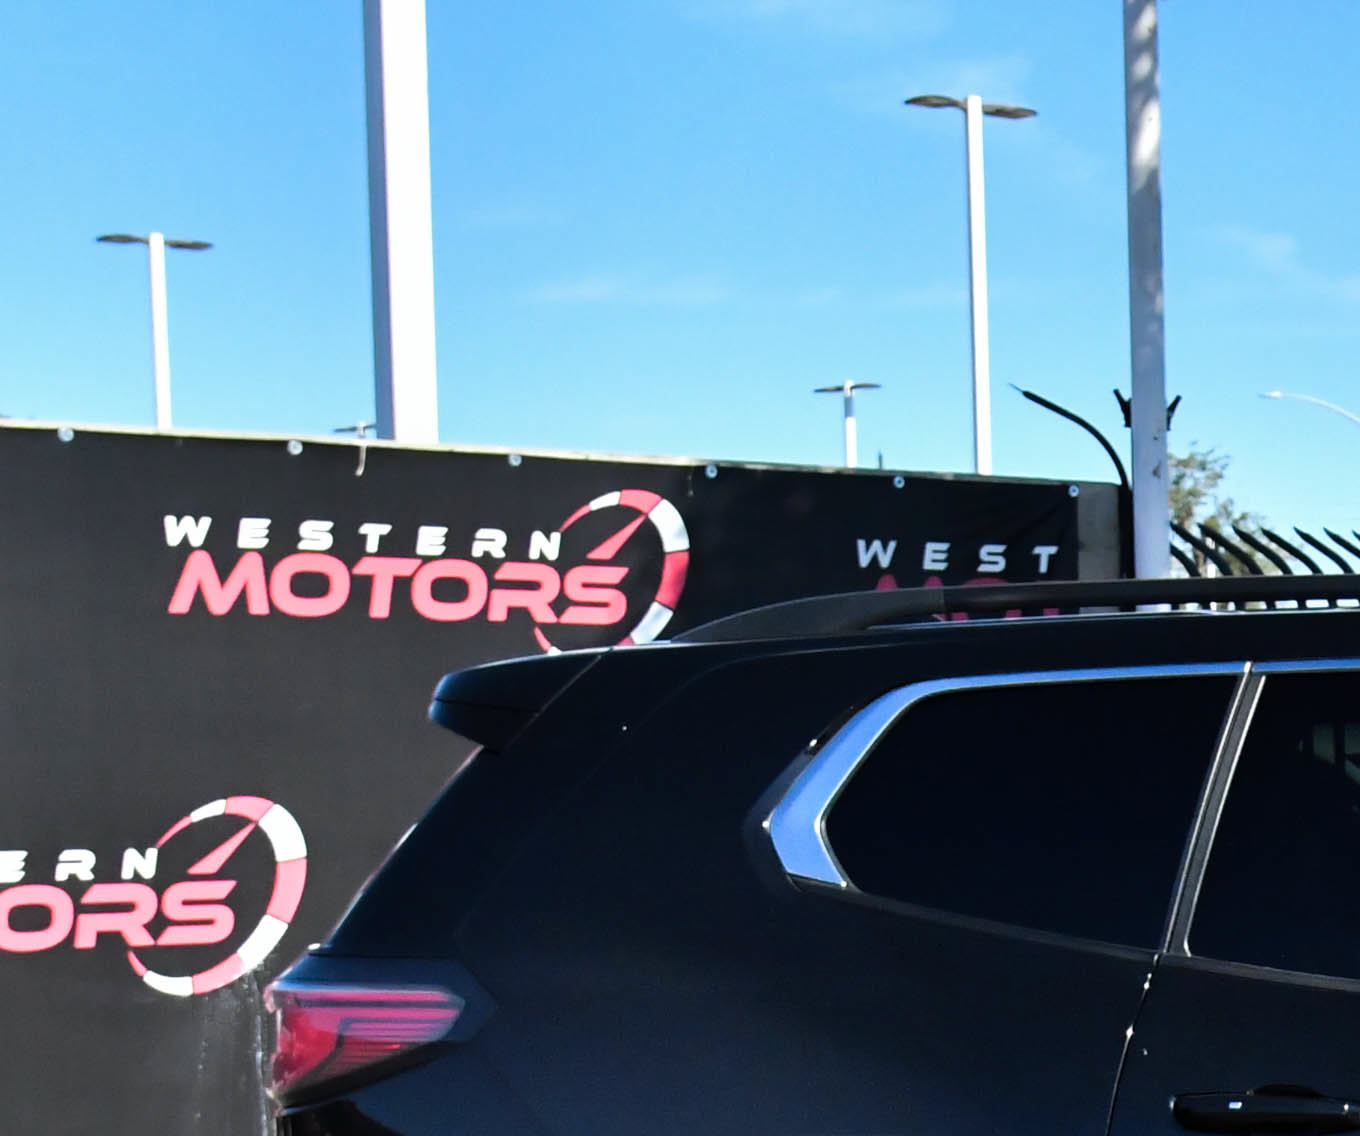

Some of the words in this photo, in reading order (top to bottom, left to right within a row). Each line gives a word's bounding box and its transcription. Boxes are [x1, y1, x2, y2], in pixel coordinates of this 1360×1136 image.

[163, 514, 563, 561] WESTERN
[856, 538, 1060, 574] WEST
[167, 549, 630, 626] MOTORS
